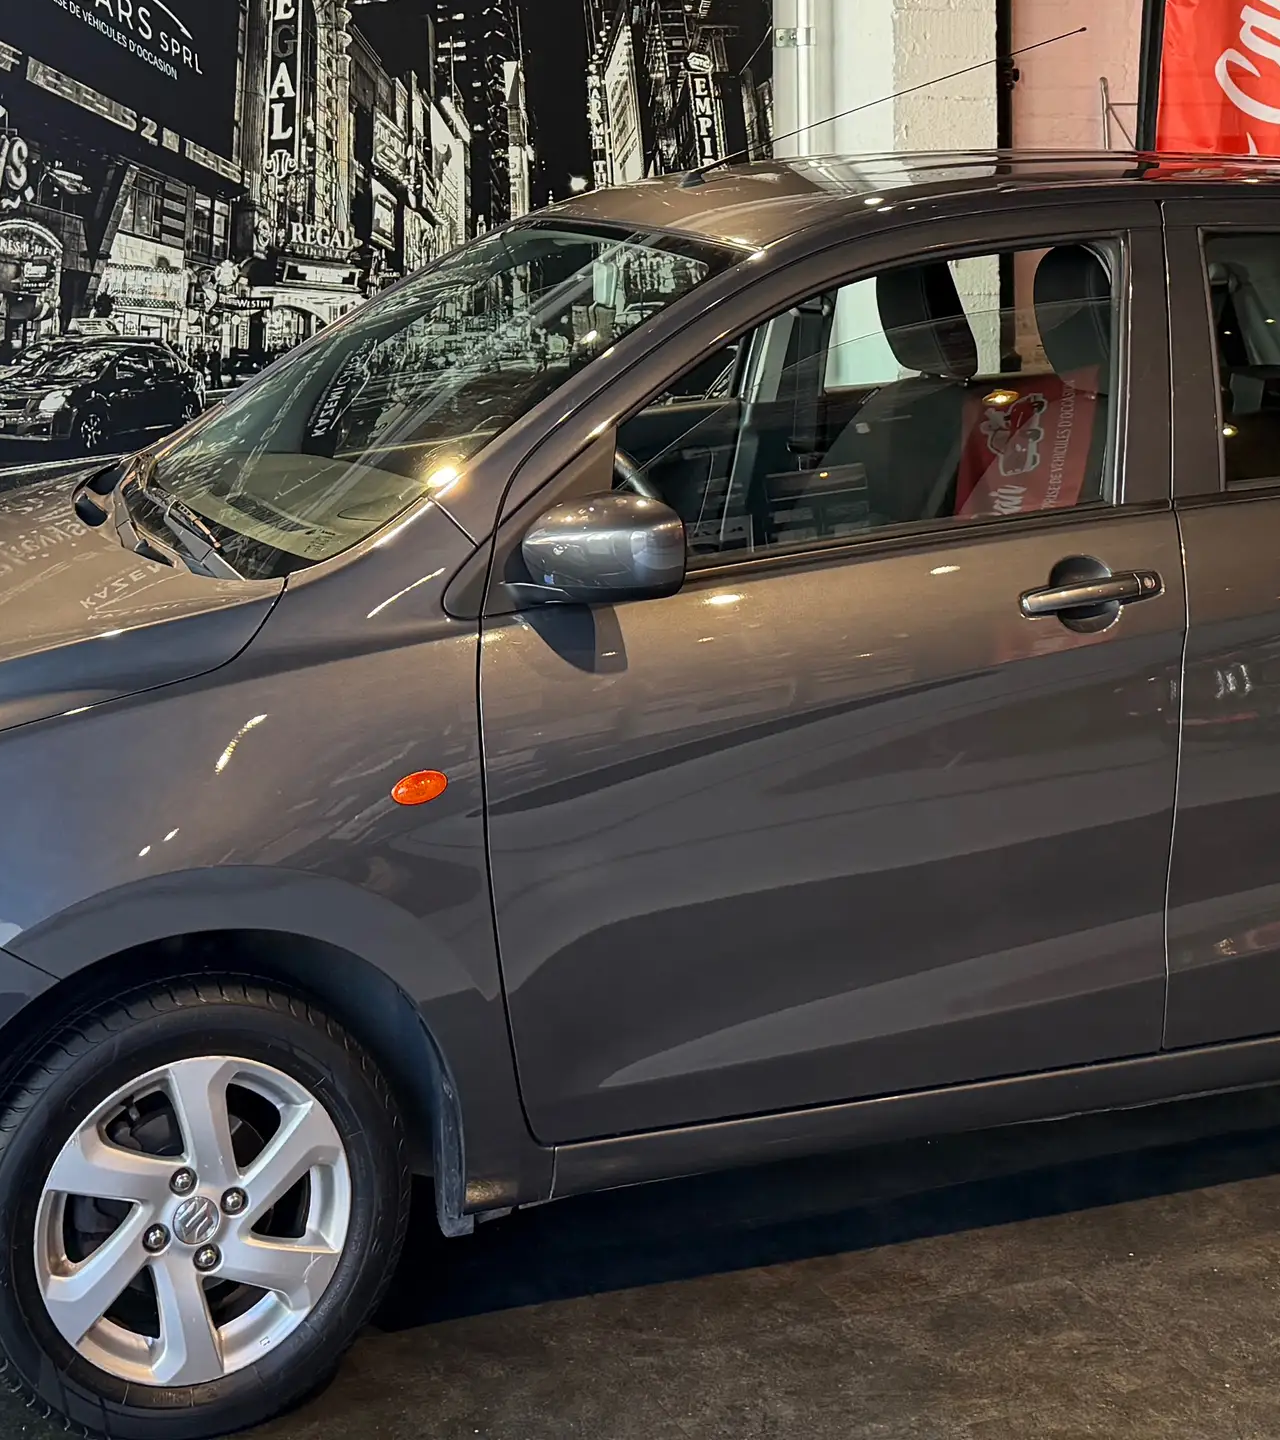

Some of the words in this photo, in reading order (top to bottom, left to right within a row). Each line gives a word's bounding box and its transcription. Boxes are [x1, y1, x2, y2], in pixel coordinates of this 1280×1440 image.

[69, 0, 82, 18] DE
[82, 10, 128, 48] VÉHICULES
[129, 39, 178, 80] D'OCCASION
[160, 33, 203, 75] SPRL
[291, 222, 354, 250] REGAL
